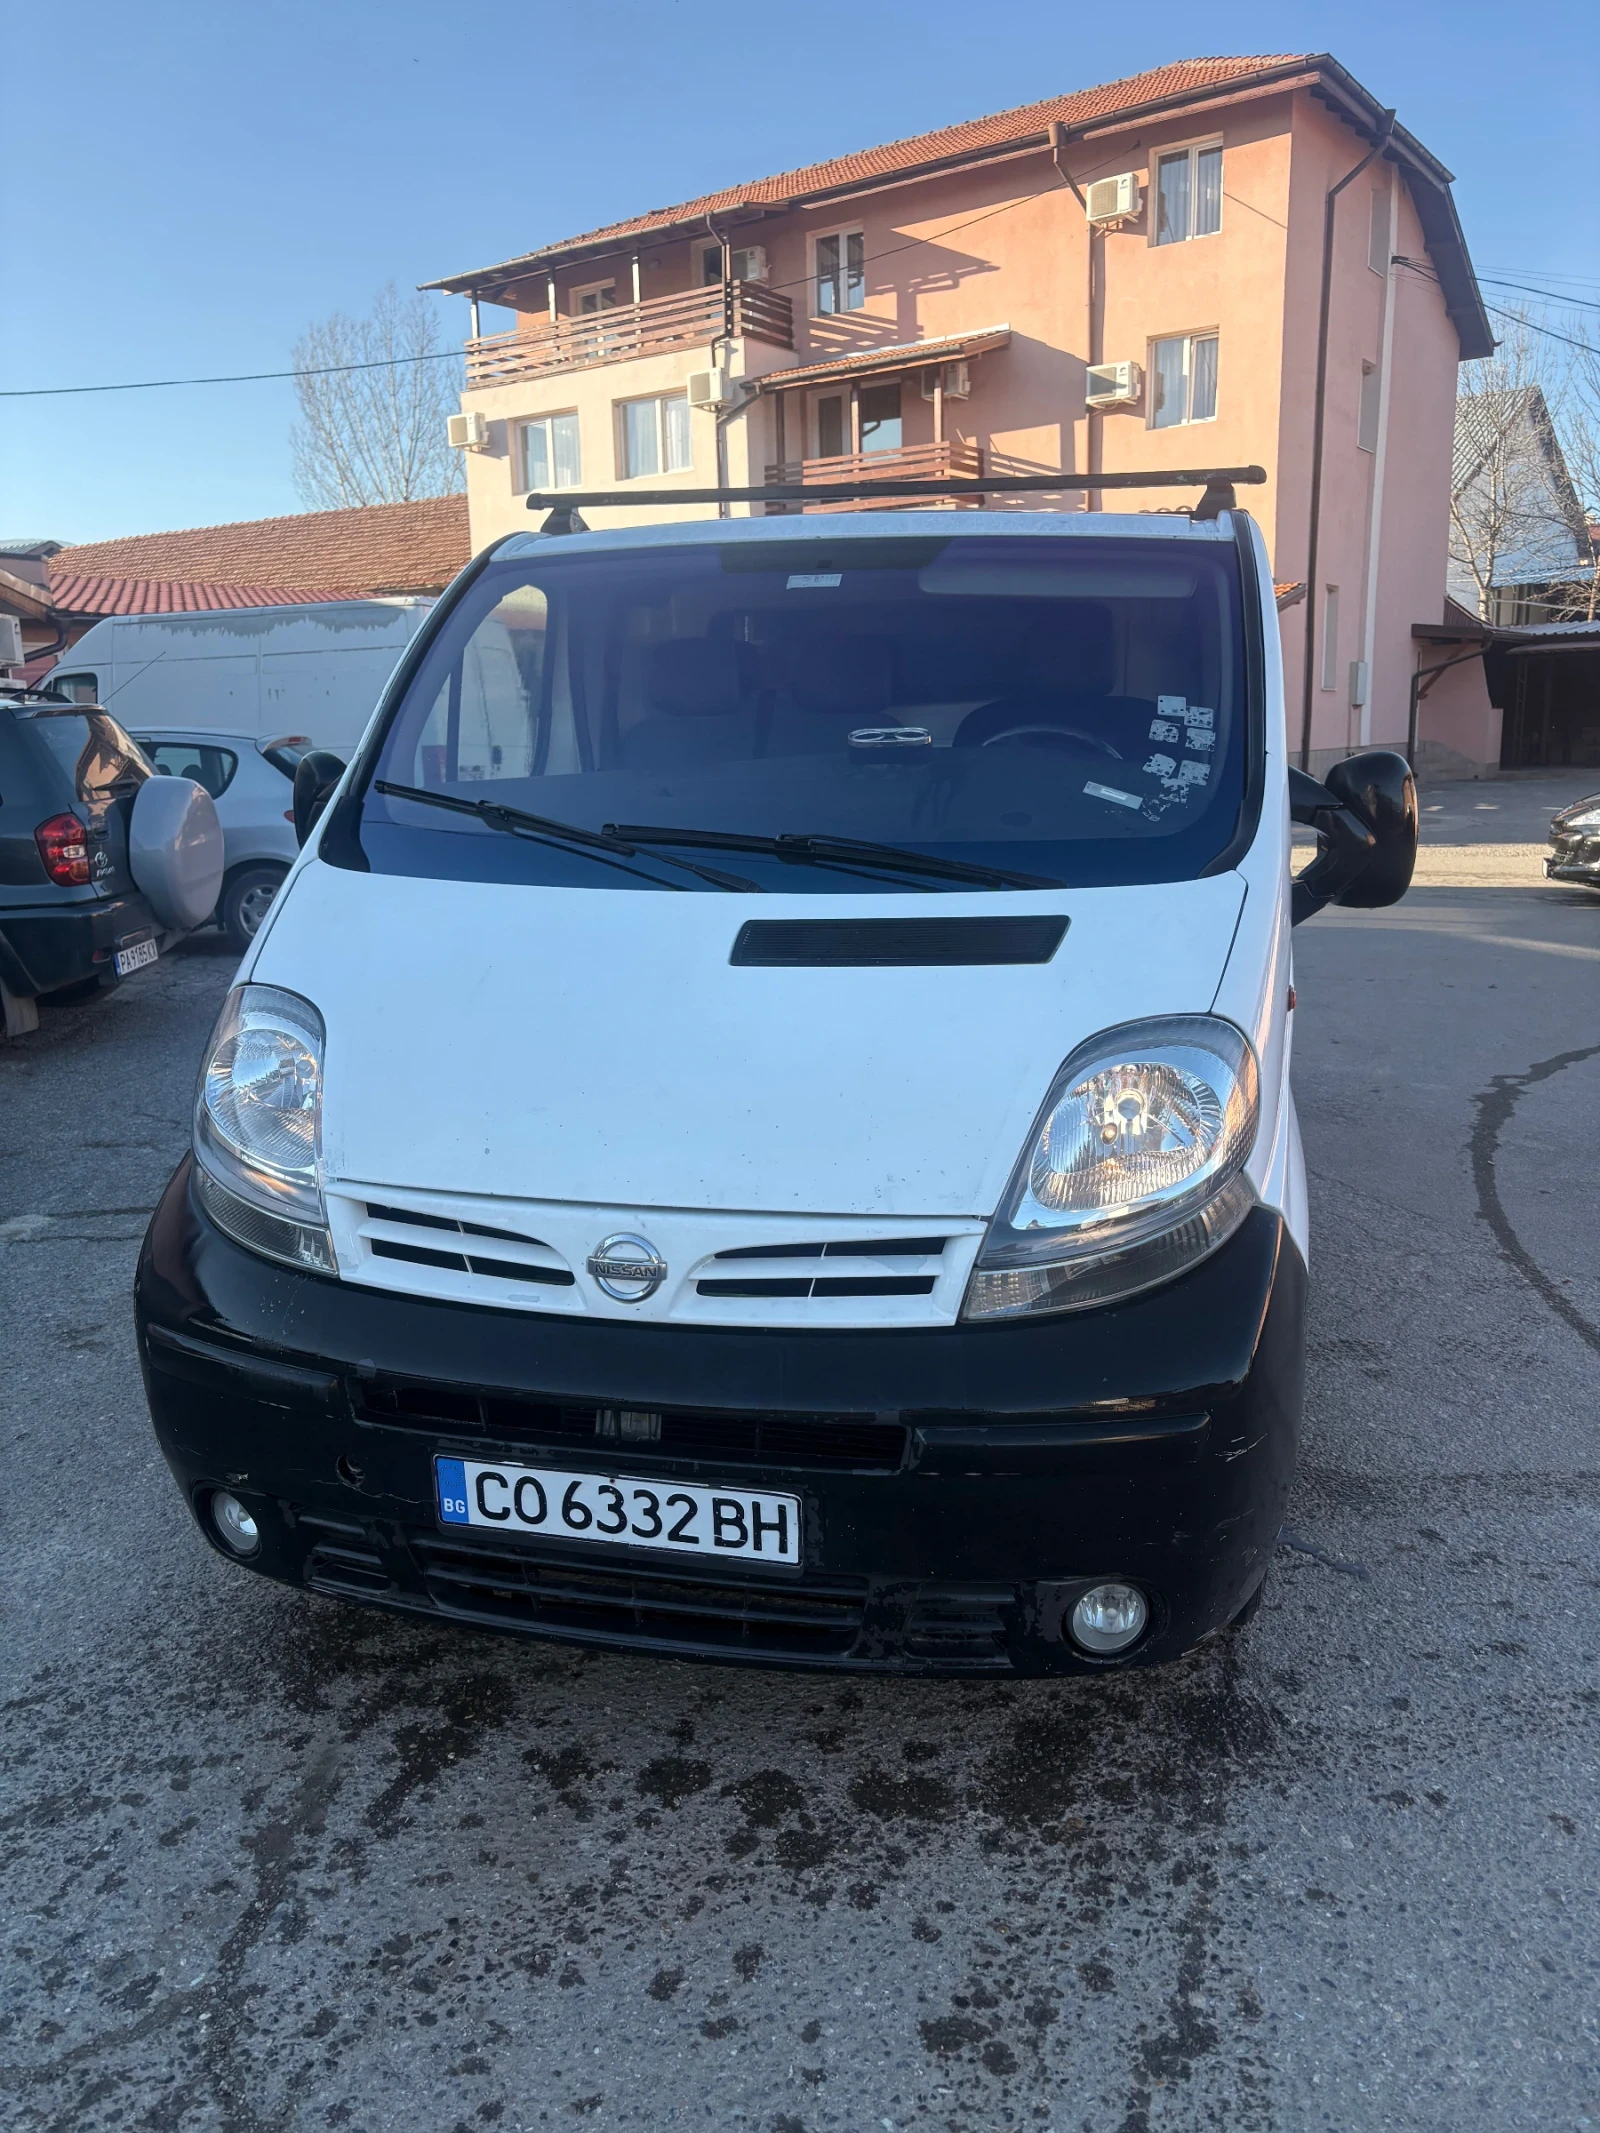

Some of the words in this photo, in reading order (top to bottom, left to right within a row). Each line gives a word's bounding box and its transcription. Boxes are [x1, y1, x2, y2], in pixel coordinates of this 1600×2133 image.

[595, 1263, 657, 1277] NISSAN
[443, 1498, 466, 1514] BG
[475, 1471, 548, 1525] CO
[561, 1480, 700, 1544] 6332
[712, 1497, 788, 1554] BH
